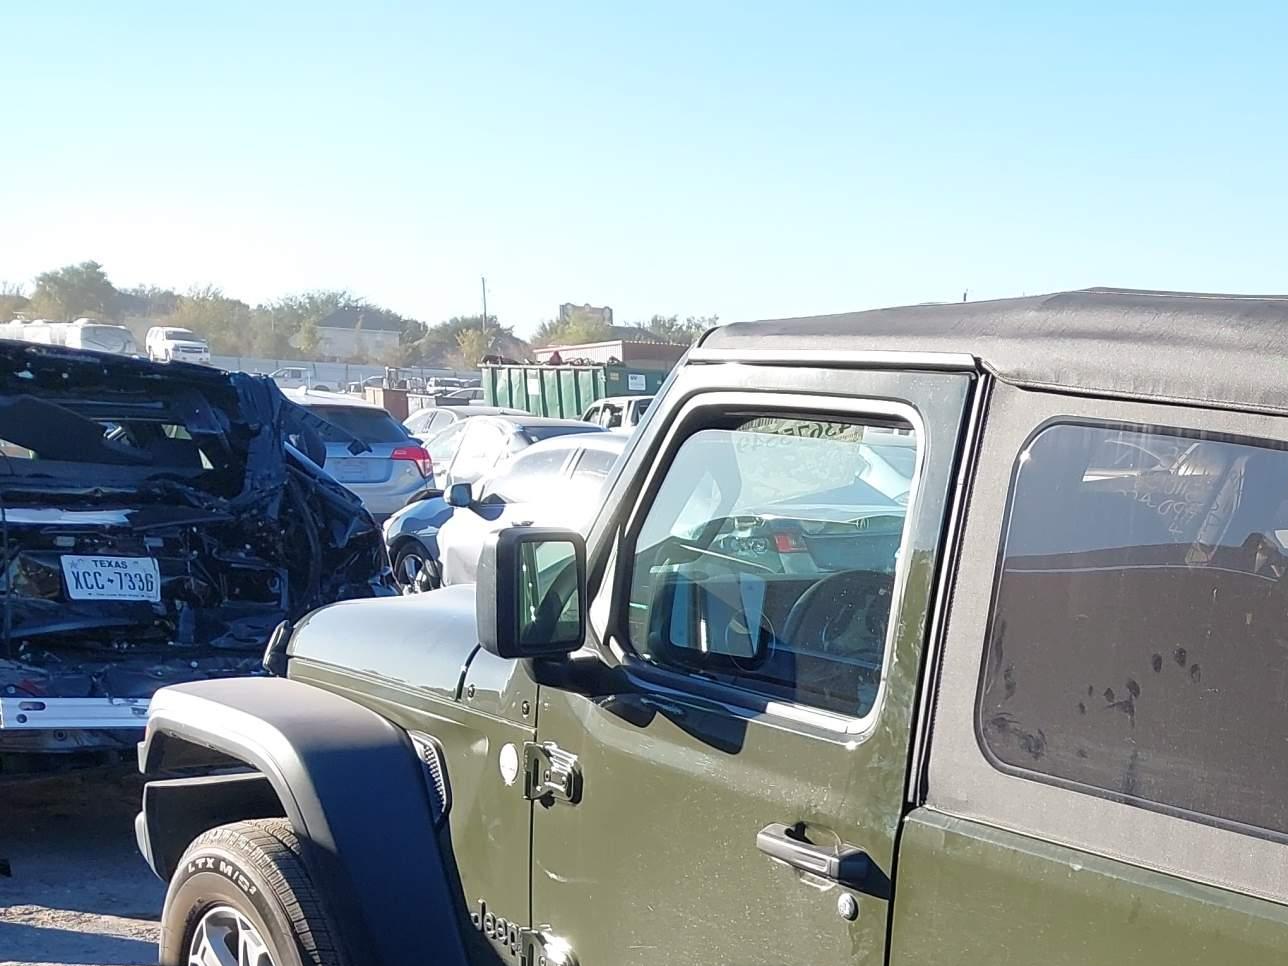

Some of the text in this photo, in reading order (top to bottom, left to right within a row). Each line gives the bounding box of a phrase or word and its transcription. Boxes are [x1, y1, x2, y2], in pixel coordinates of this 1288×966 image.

[91, 560, 128, 569] TEXAS
[187, 857, 216, 874] LTX
[470, 898, 522, 956] Jeep
